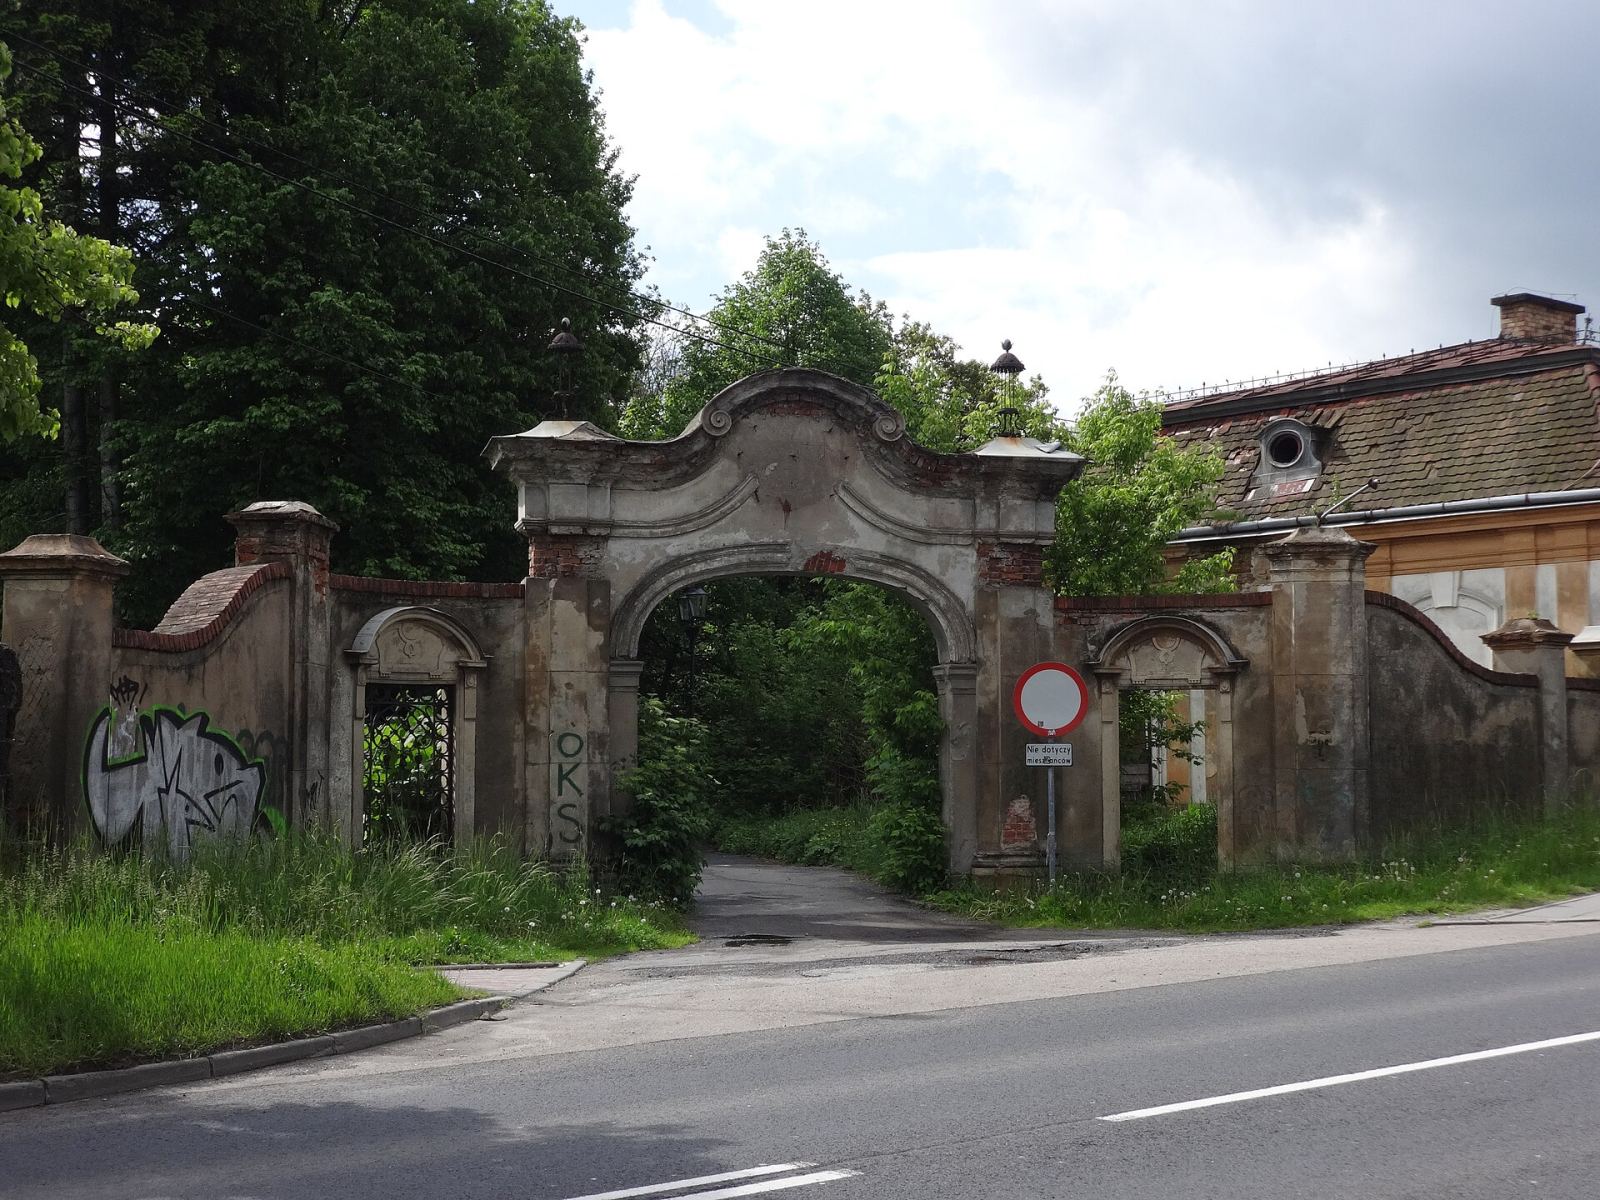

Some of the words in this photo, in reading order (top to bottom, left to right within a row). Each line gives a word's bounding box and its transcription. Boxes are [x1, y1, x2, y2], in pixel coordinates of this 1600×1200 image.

[1027, 745, 1039, 754] Nie
[1041, 745, 1071, 756] dotyczy
[557, 732, 584, 844] OKS
